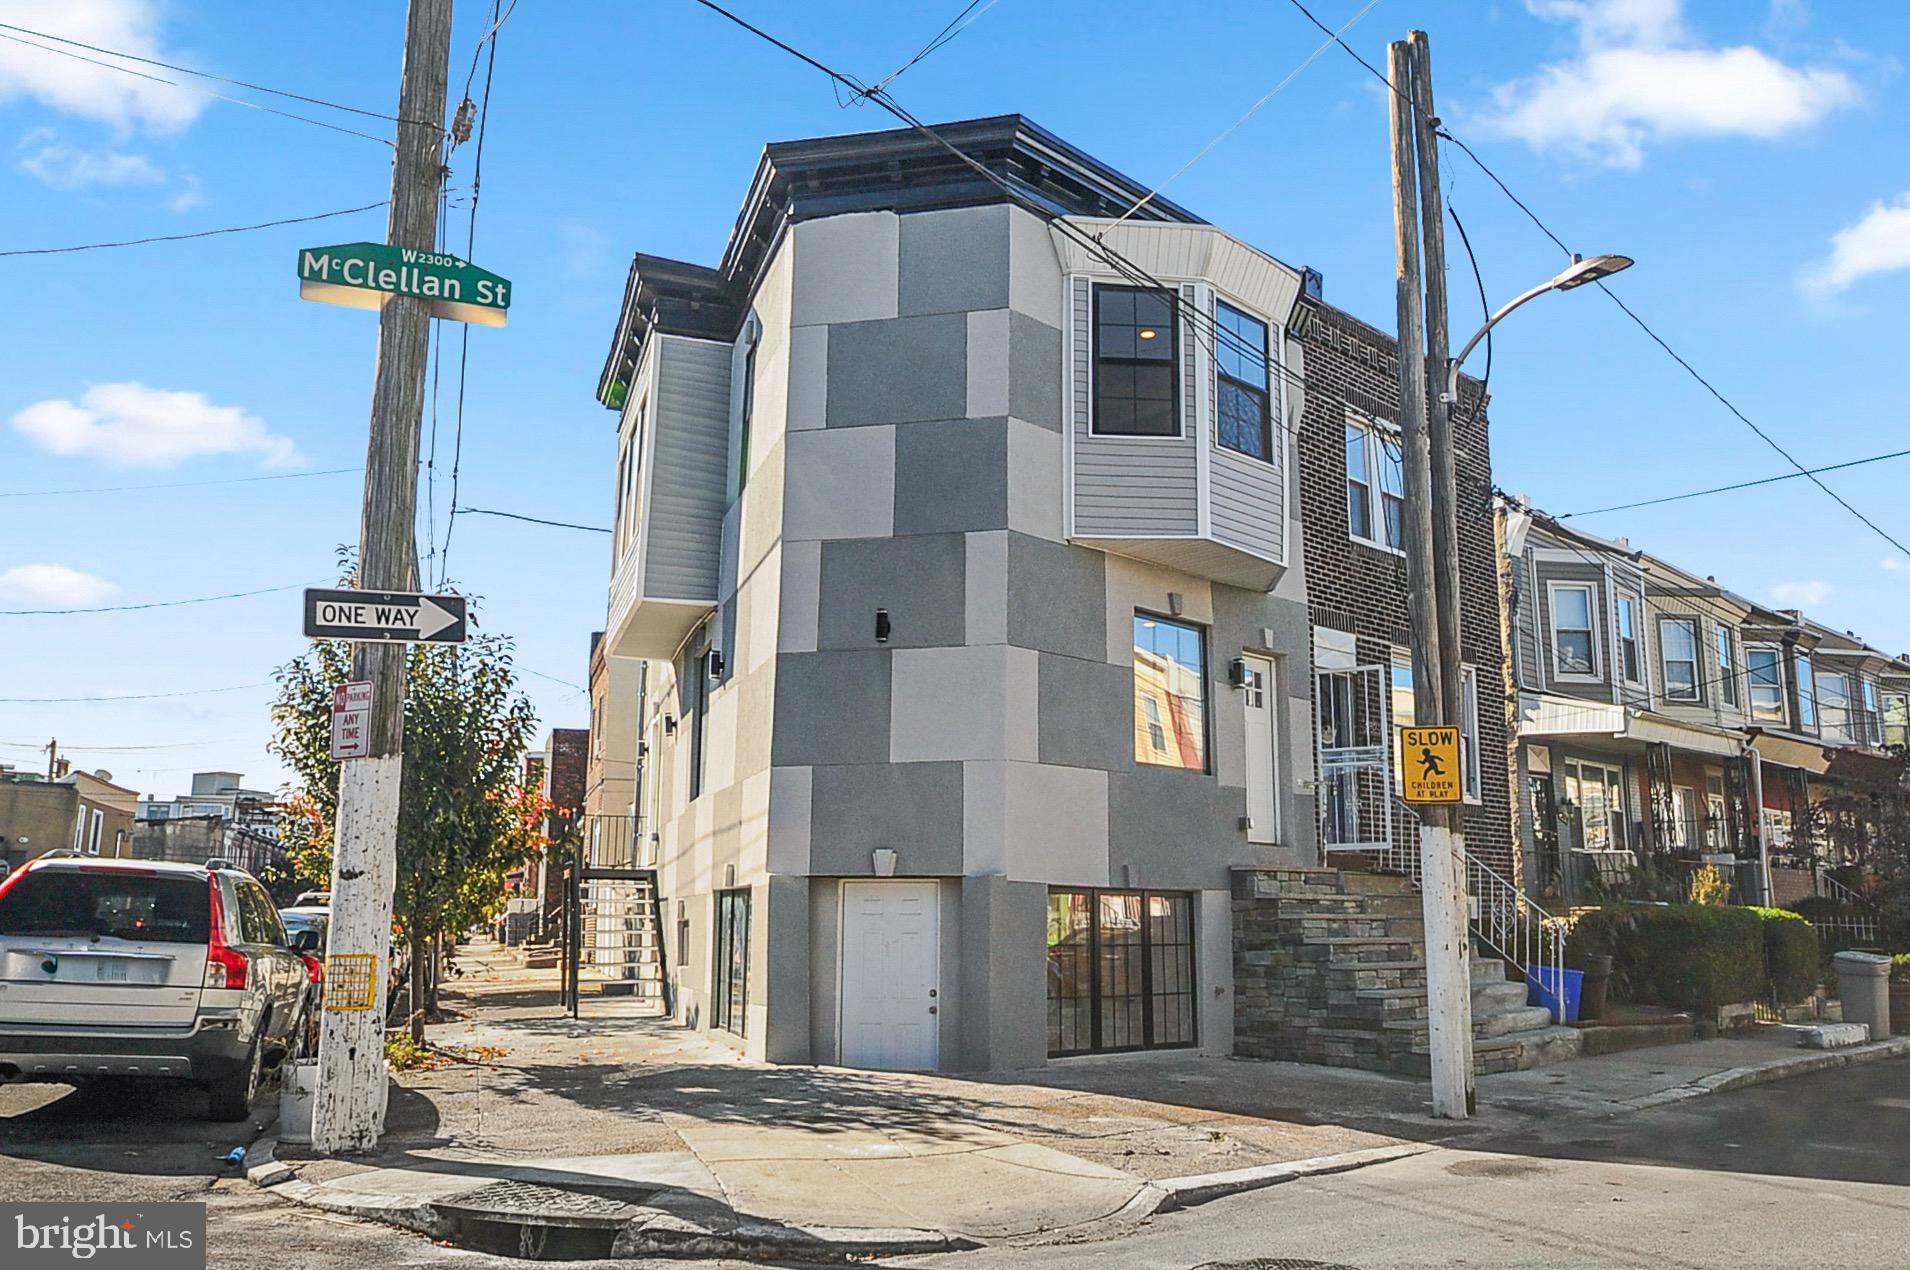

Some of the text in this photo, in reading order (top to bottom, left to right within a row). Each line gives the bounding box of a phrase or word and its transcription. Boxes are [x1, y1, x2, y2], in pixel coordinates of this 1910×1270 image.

[303, 251, 507, 307] McClellan St
[322, 604, 420, 627] ONE WAY
[343, 713, 360, 727] ANY
[341, 727, 360, 740] TIME
[1407, 731, 1453, 746] SLOW
[1411, 781, 1454, 790] CHILDREN
[1416, 790, 1449, 798] AT PLAY
